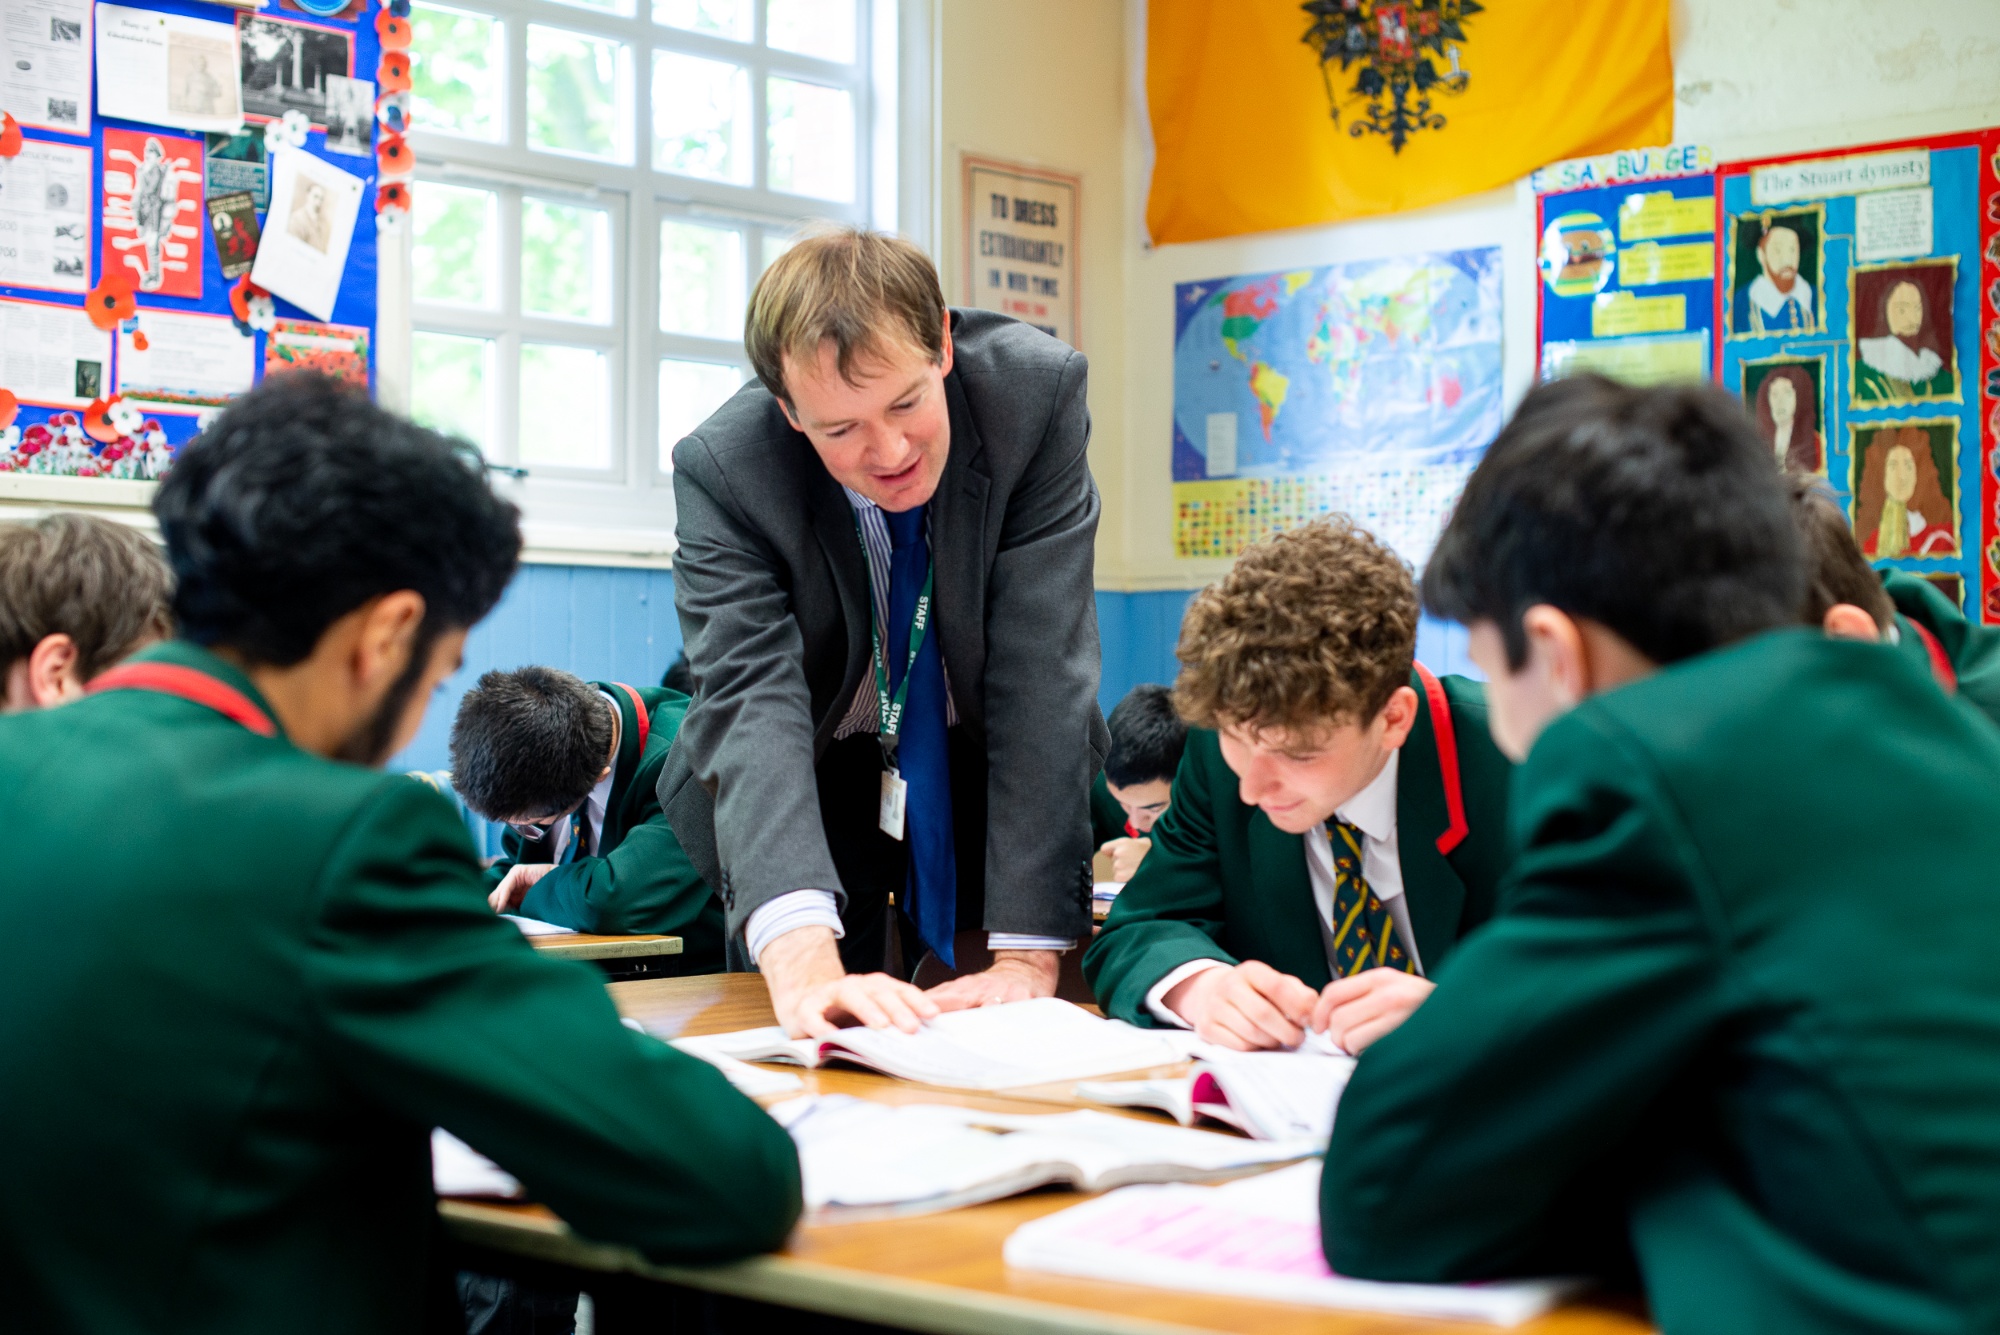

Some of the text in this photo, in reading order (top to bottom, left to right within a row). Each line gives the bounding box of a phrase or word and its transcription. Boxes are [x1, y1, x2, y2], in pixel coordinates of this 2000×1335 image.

[1531, 145, 1713, 192] ESSAY BURGER
[1761, 160, 1927, 192] The Stuart dynasty
[991, 192, 1058, 228] TO DRESS
[914, 595, 929, 630] STAFF
